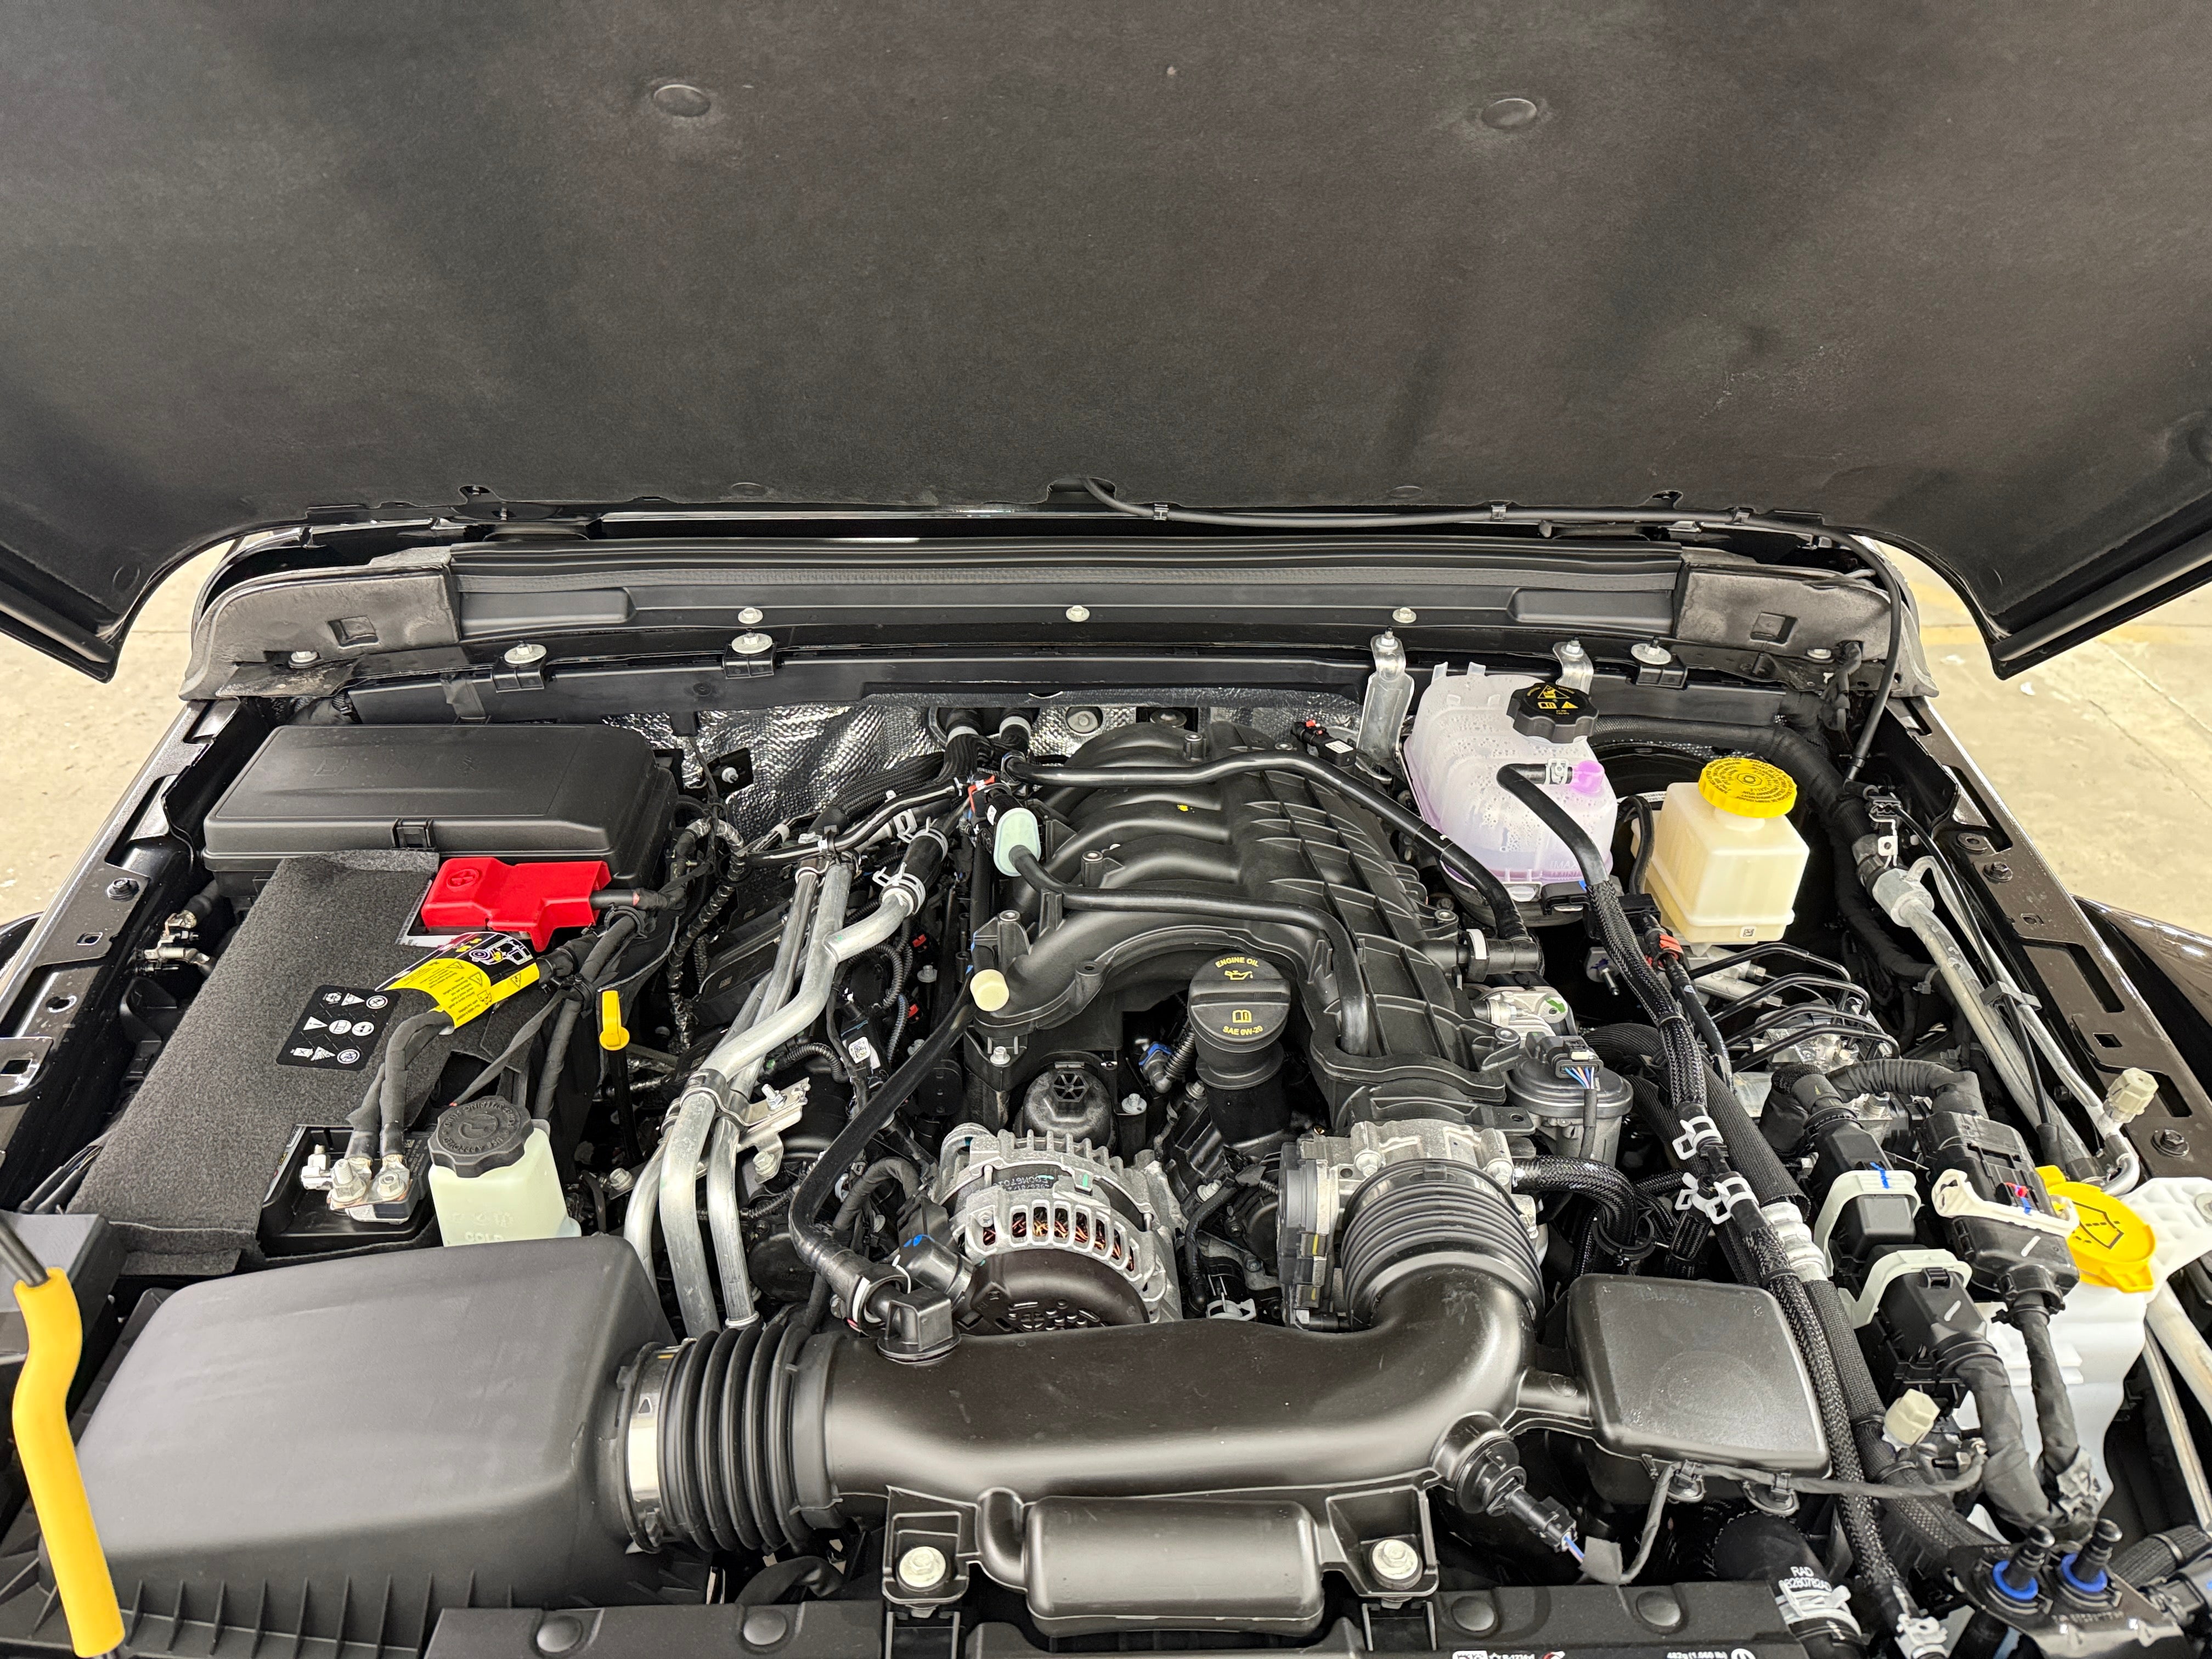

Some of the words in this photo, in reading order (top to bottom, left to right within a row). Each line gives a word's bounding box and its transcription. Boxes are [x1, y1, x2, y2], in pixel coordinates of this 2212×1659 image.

[1215, 957, 1245, 968] ENGINE
[1246, 958, 1259, 967] OIL
[1222, 1025, 1239, 1035] SAE
[1240, 1025, 1263, 1035] 0W-20
[462, 1101, 505, 1113] STEERING
[443, 1109, 462, 1127] FLUID
[502, 1106, 516, 1128] POWER
[443, 1137, 483, 1153] APPROVED
[487, 1137, 503, 1148] USE
[464, 1231, 504, 1243] COLD
[1790, 1566, 1814, 1577] RAD
